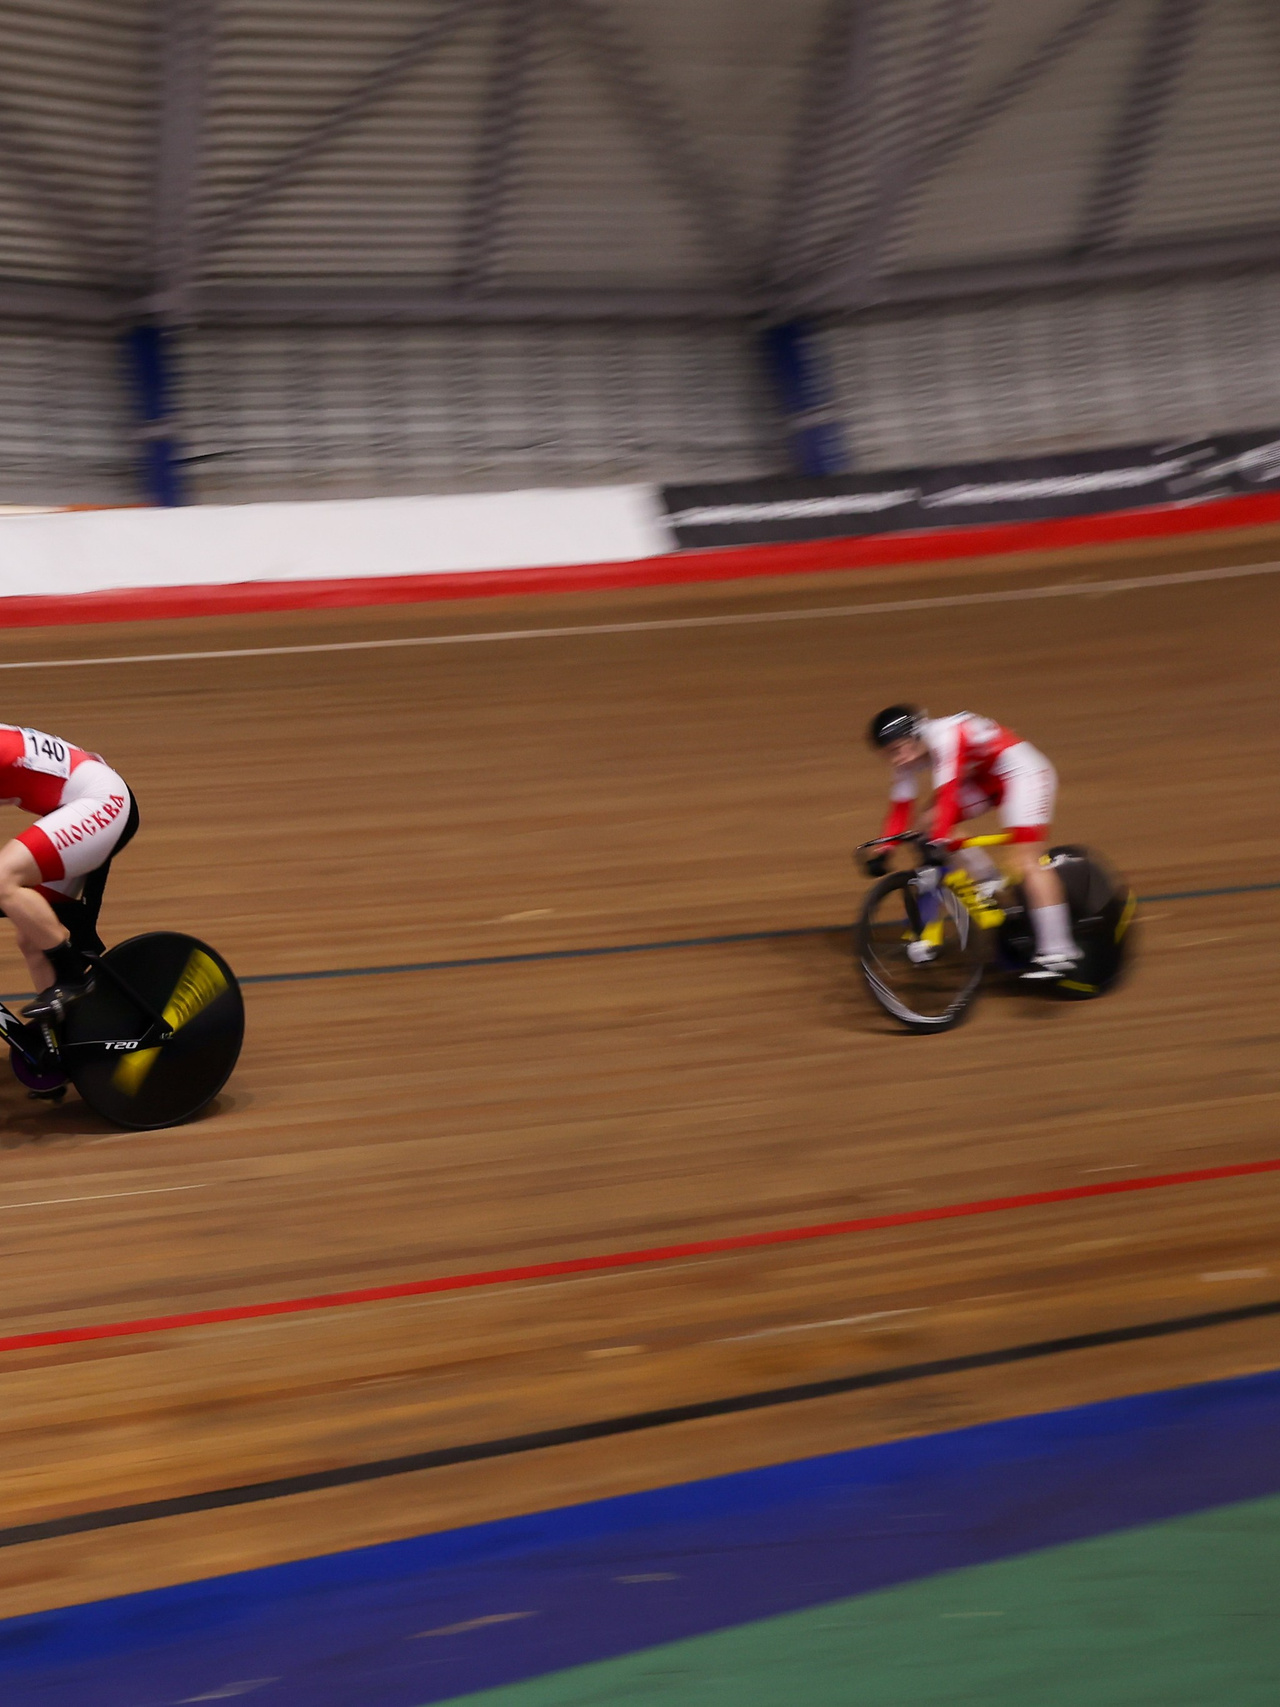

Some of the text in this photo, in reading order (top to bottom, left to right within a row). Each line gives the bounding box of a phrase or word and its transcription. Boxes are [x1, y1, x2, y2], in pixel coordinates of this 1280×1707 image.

[29, 736, 65, 762] 140
[53, 794, 125, 850] МОСКВА
[104, 1041, 139, 1050] T20
